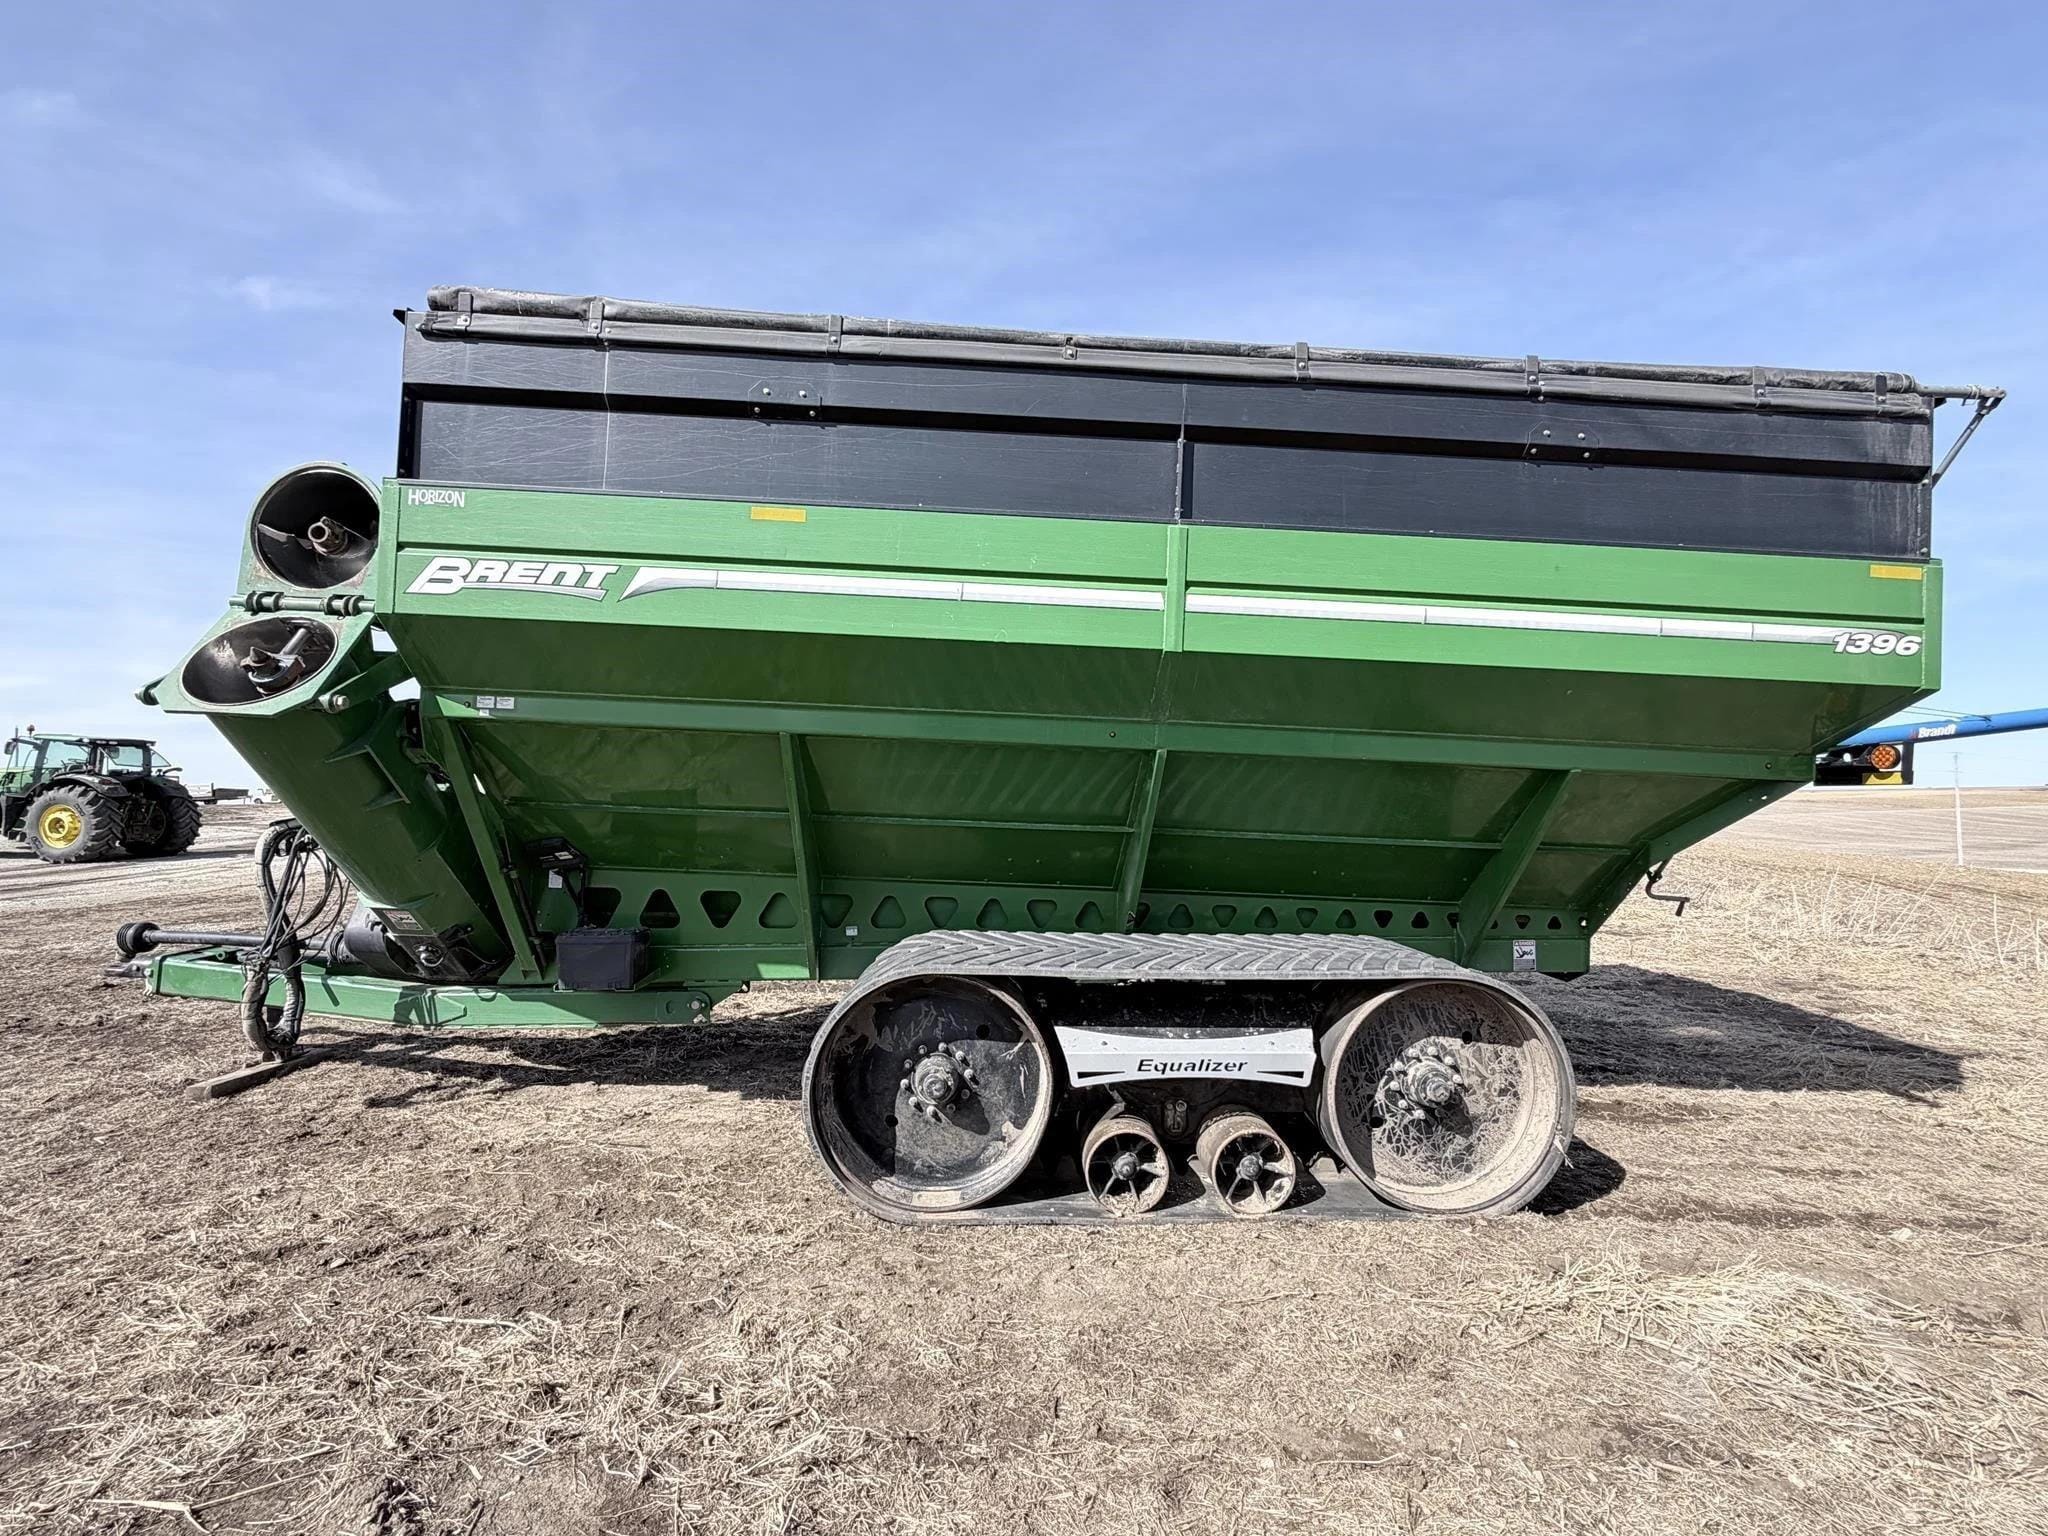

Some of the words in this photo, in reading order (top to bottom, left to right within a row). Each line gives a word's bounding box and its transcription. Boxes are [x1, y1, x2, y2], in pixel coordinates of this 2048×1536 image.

[408, 488, 465, 508] HORIZON
[1833, 632, 1922, 656] 1396
[1918, 724, 1957, 738] Brandt
[1137, 1058, 1248, 1075] Equalizer
